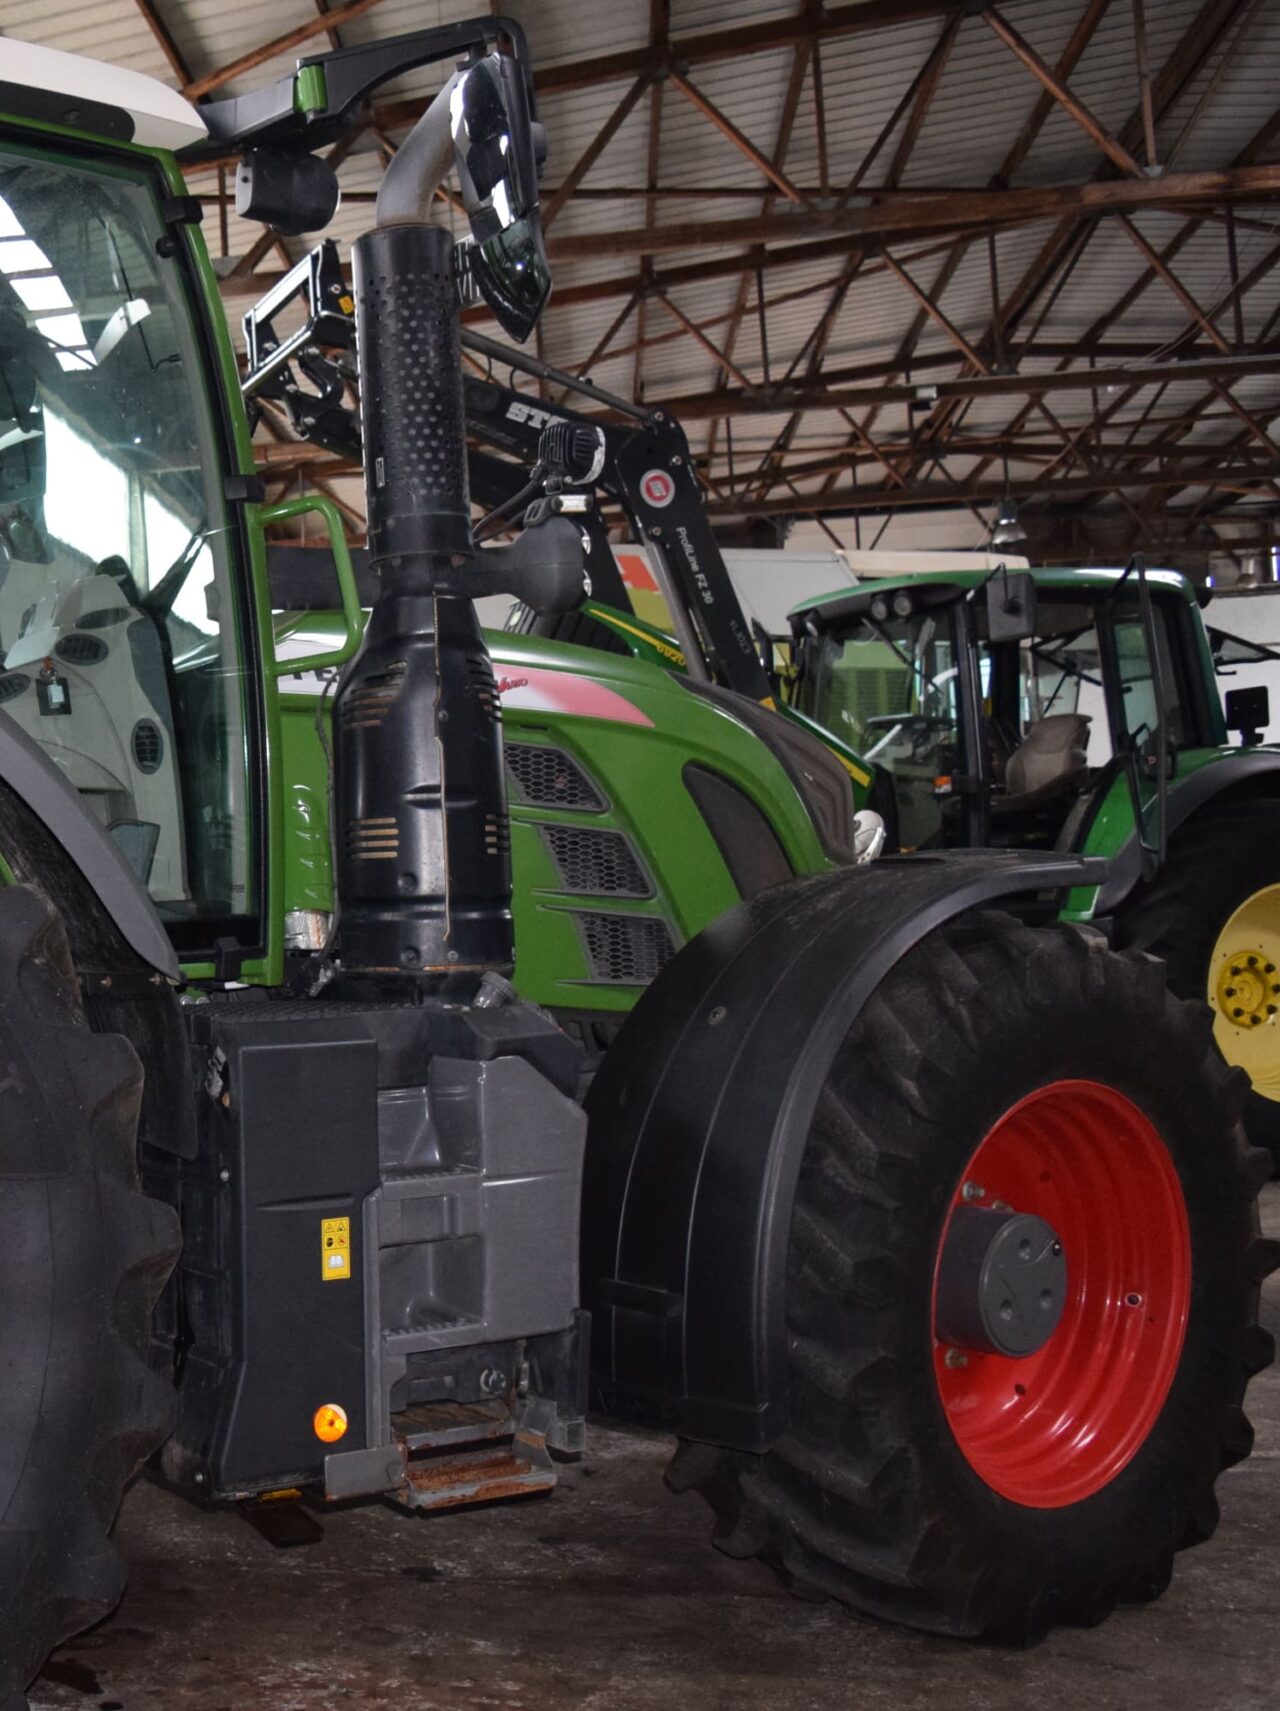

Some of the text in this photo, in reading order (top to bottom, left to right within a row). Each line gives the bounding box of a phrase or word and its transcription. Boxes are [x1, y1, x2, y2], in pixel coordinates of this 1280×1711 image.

[675, 526, 714, 605] ProfiLine FZ 30
